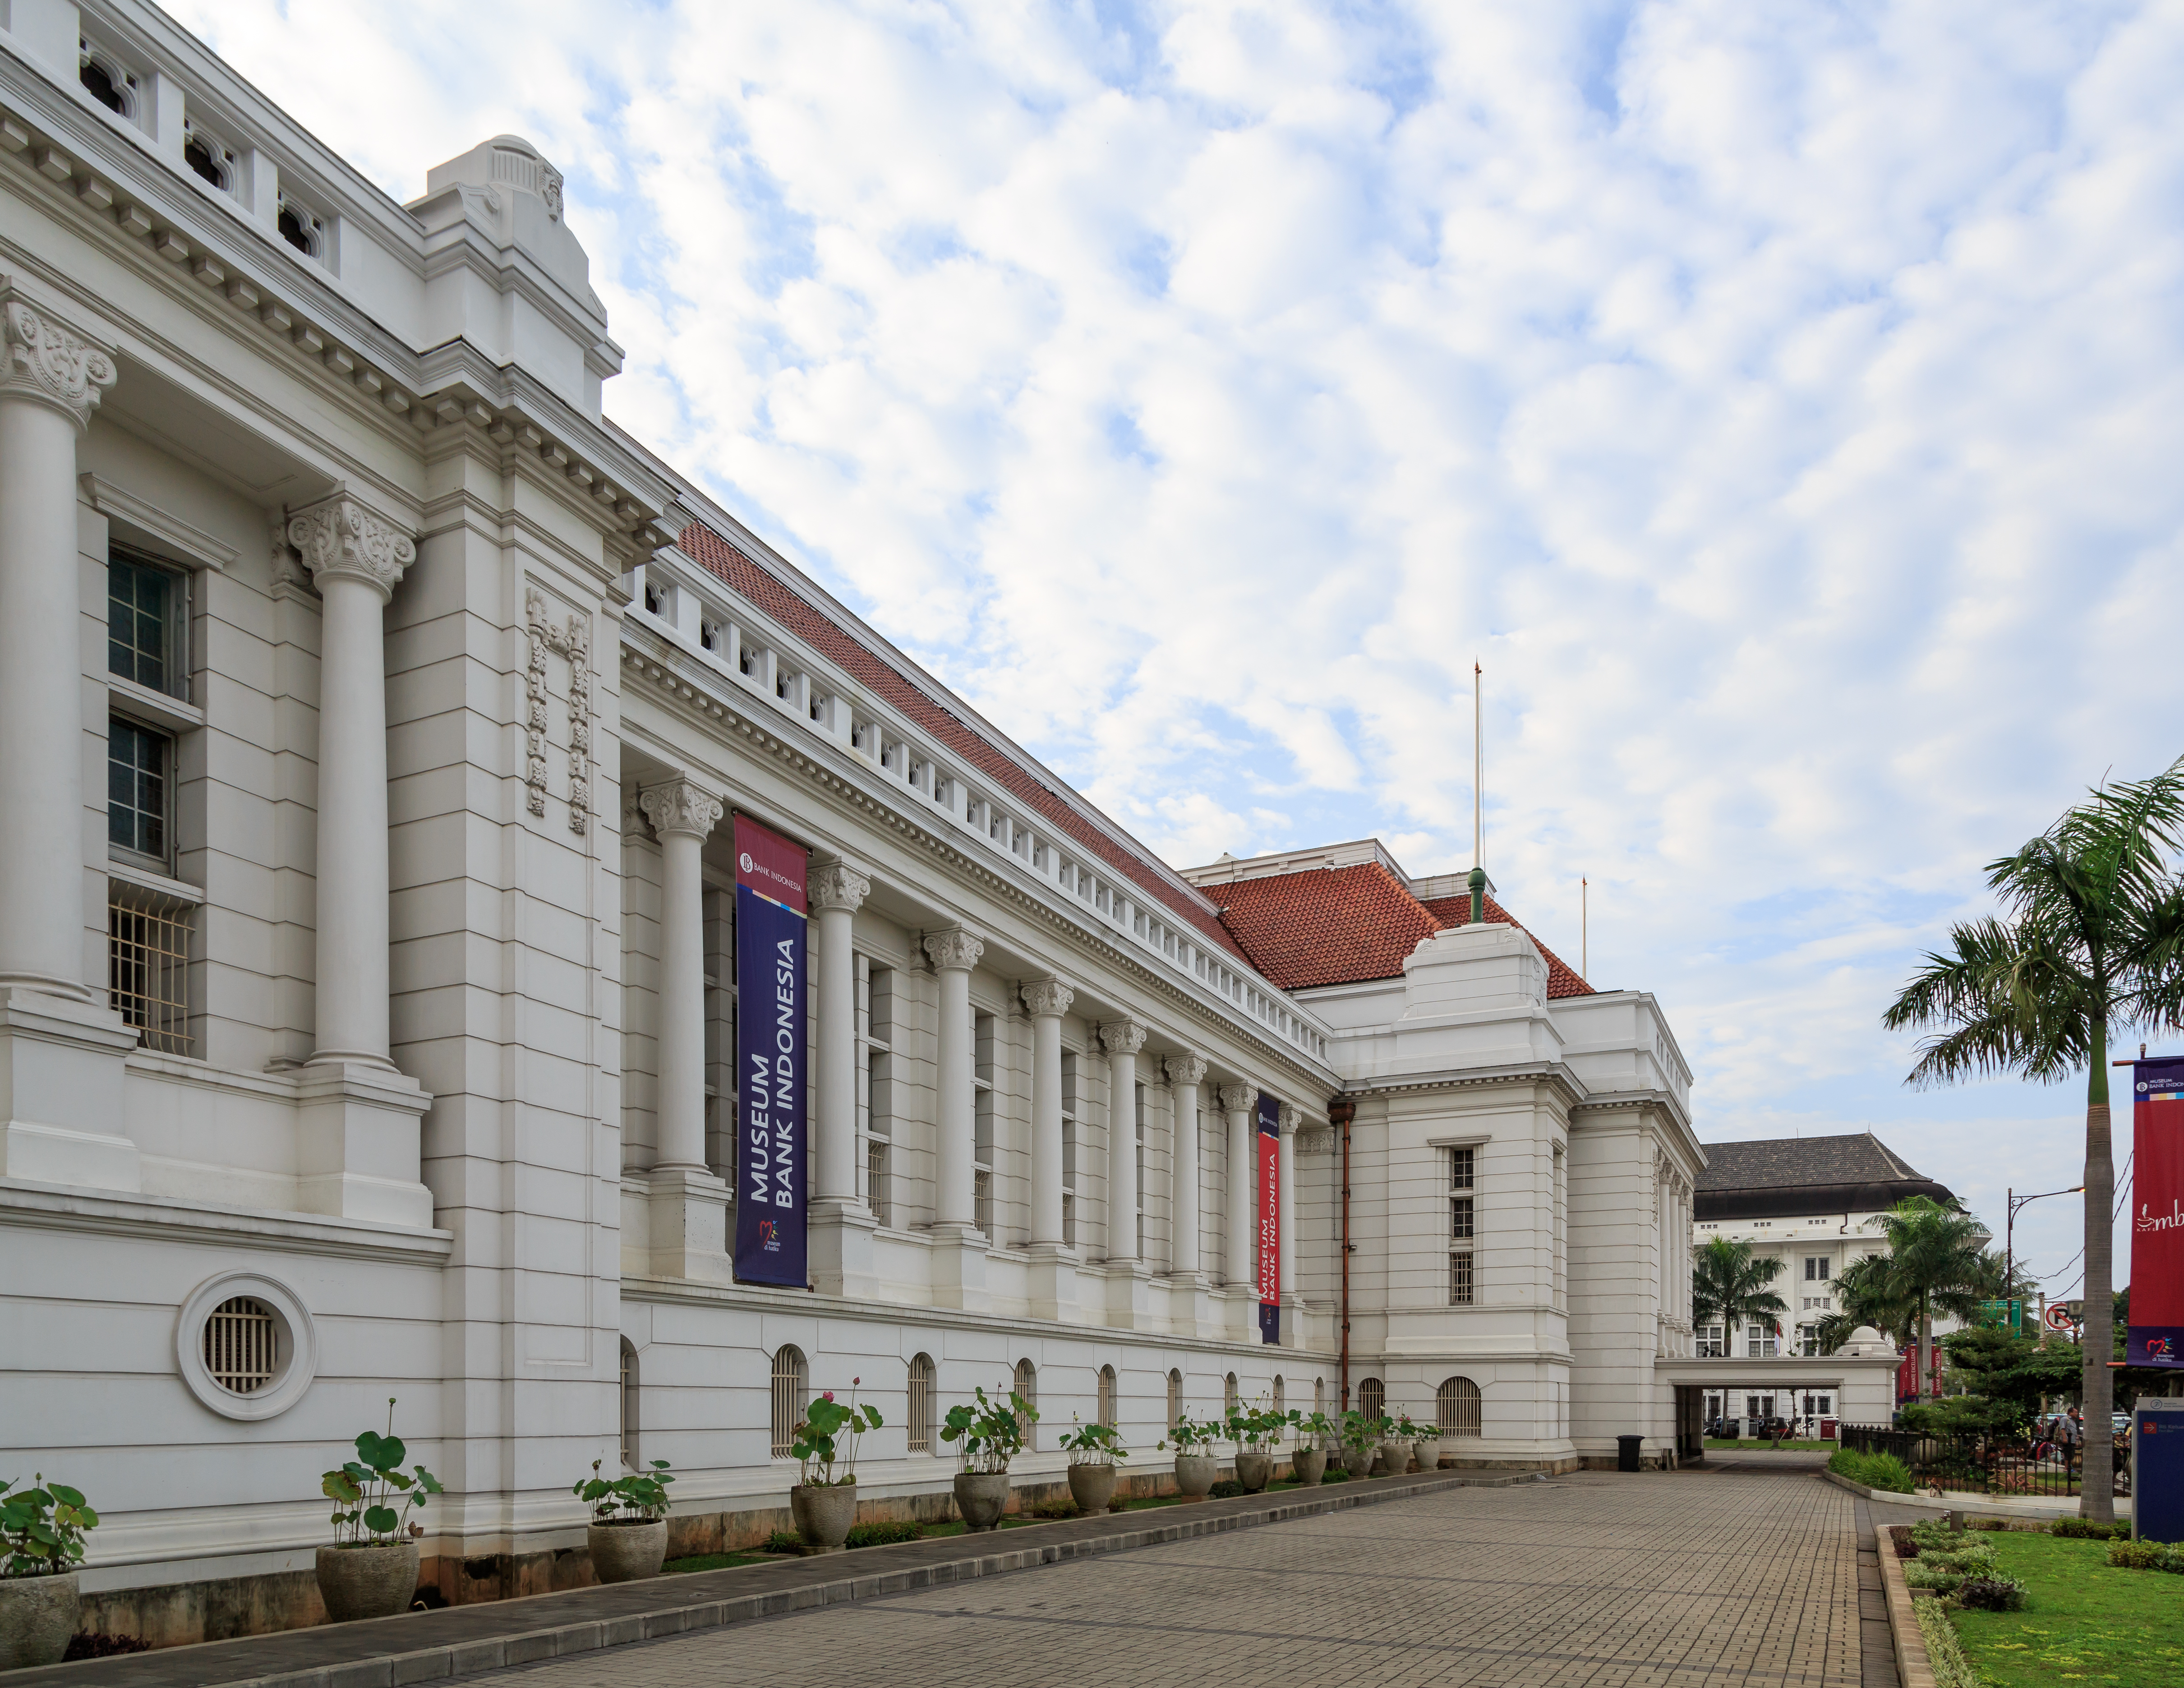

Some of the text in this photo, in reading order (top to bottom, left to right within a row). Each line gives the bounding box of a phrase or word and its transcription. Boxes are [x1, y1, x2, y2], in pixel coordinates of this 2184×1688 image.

[754, 862, 802, 893] BANK INDONESIA
[751, 1054, 769, 1203] MUSEUM
[776, 939, 793, 1208] BANK INDONESIA
